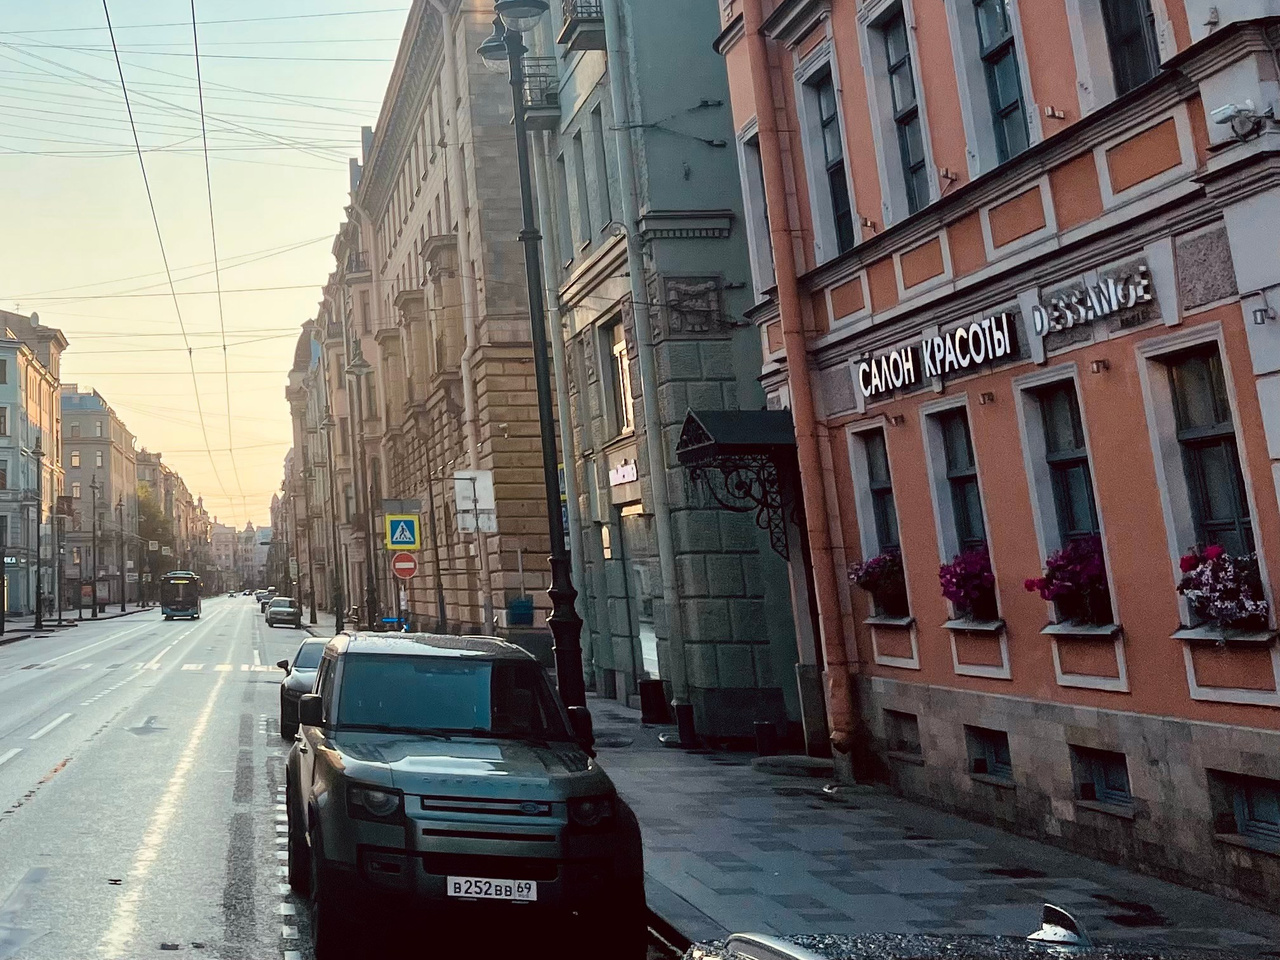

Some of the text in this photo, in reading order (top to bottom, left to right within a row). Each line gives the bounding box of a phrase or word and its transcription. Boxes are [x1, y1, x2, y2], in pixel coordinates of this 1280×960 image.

[1033, 265, 1153, 338] DESSANGE
[859, 313, 1012, 398] САЛОН КРАСОТЫ
[453, 879, 532, 897] В252ВВ 69
